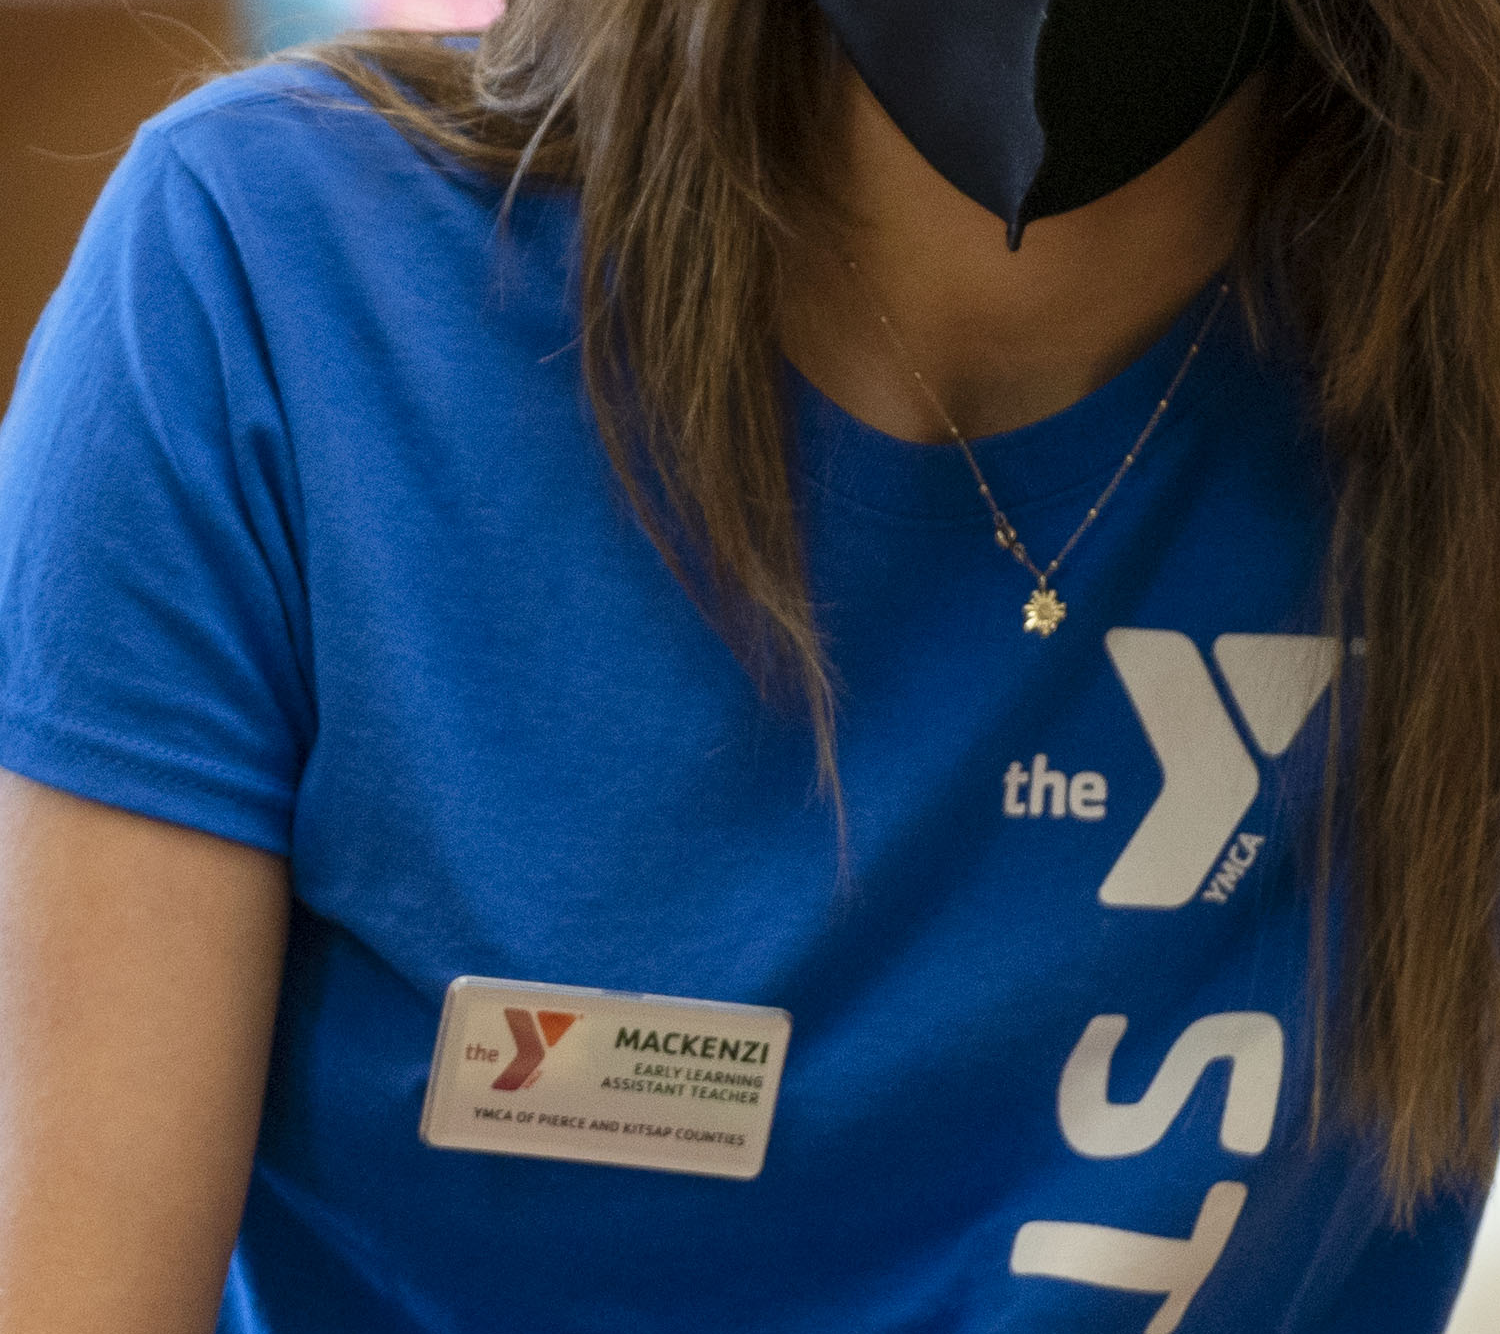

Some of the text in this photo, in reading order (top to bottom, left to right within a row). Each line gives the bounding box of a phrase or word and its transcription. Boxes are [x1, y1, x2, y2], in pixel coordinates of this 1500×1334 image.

[1002, 754, 1108, 820] the
[1202, 830, 1266, 905] YMCA
[465, 1043, 499, 1062] the
[615, 1026, 770, 1064] MACKENZI
[601, 1076, 760, 1104] ASSISTANT TEACHER
[634, 1062, 764, 1088] EARLY LEARNING
[474, 1107, 746, 1146] YMCA OF PIERCE AND KITSAP COUNTIES
